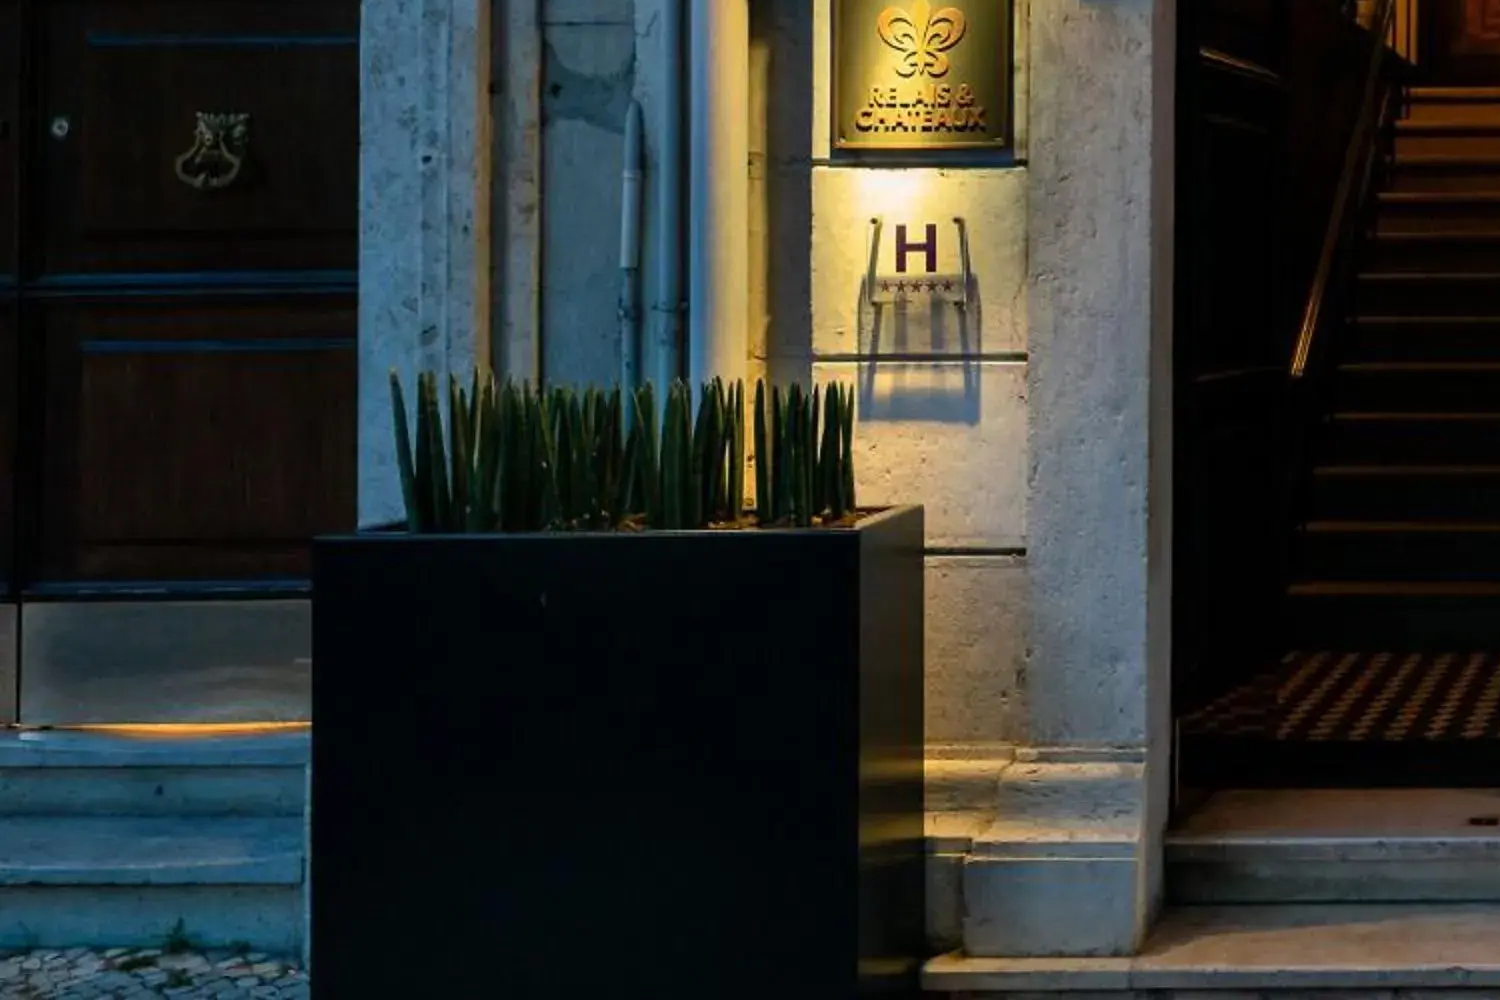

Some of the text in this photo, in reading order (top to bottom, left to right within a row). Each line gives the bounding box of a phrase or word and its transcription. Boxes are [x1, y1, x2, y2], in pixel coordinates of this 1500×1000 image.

[869, 83, 976, 109] RELAIS &
[896, 224, 937, 273] H
